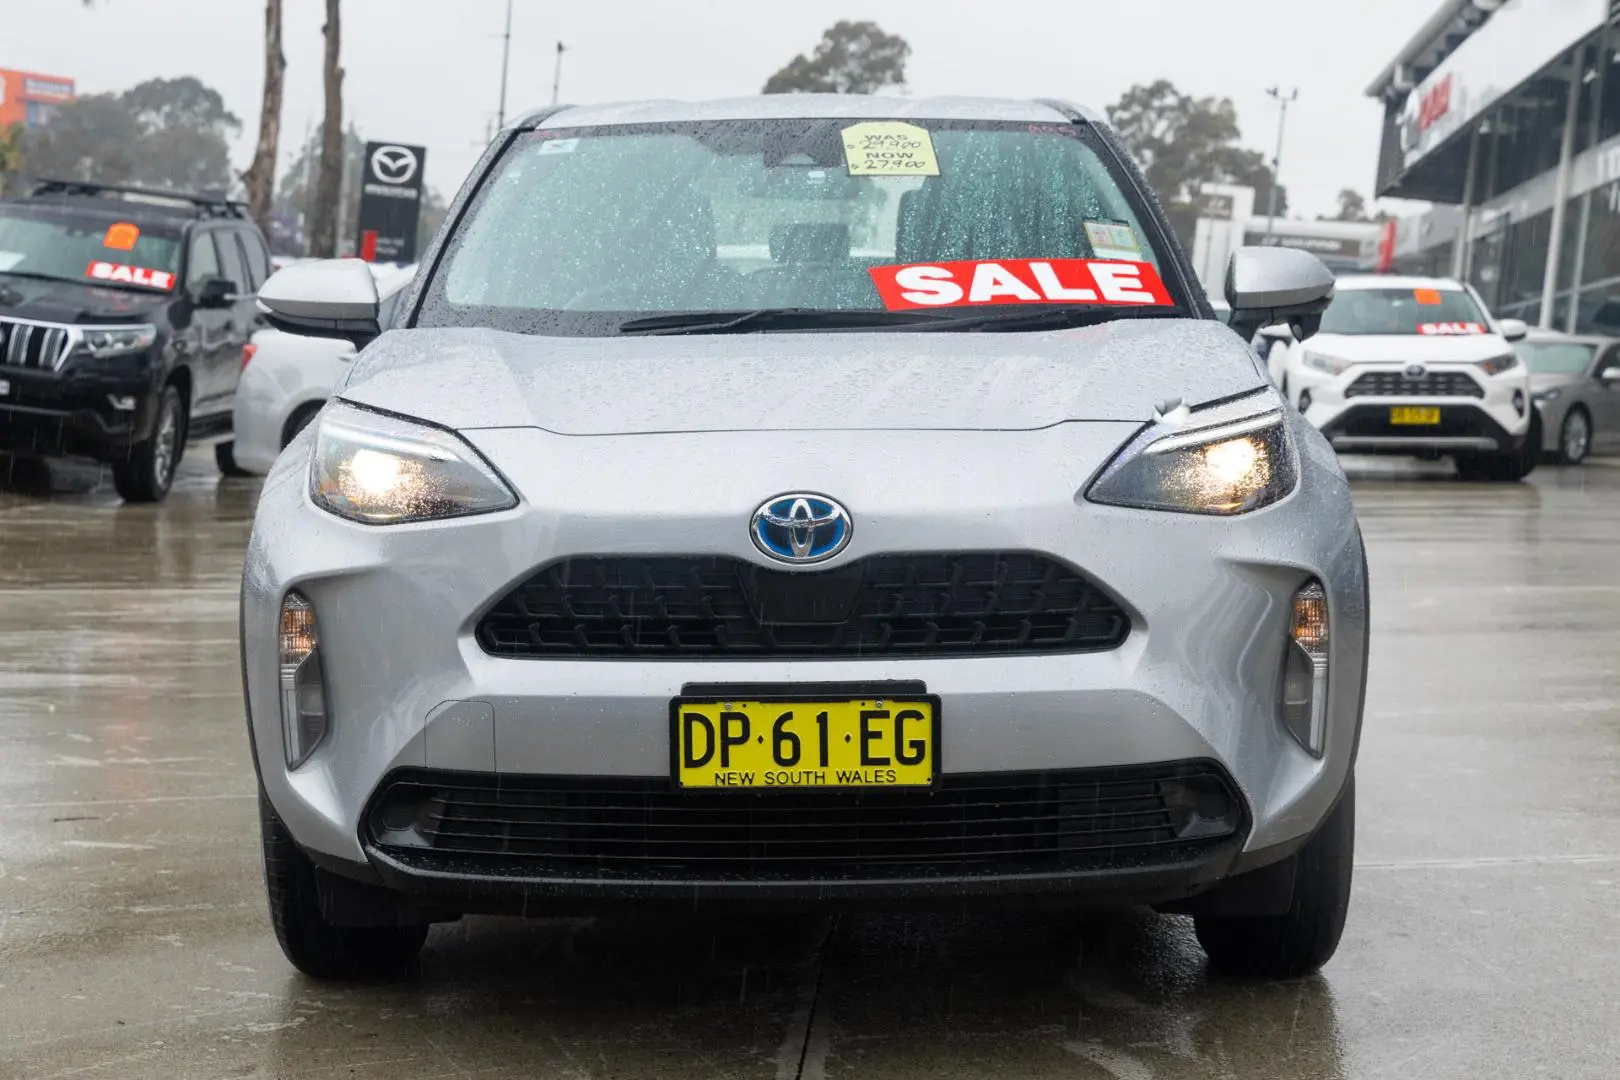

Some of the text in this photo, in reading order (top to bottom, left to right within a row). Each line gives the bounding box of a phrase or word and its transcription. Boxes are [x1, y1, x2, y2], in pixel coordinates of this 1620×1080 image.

[92, 261, 170, 289] SALE
[895, 262, 1156, 306] SALE
[1420, 322, 1483, 336] SALE
[715, 769, 897, 785] NEW SOUTH WALES
